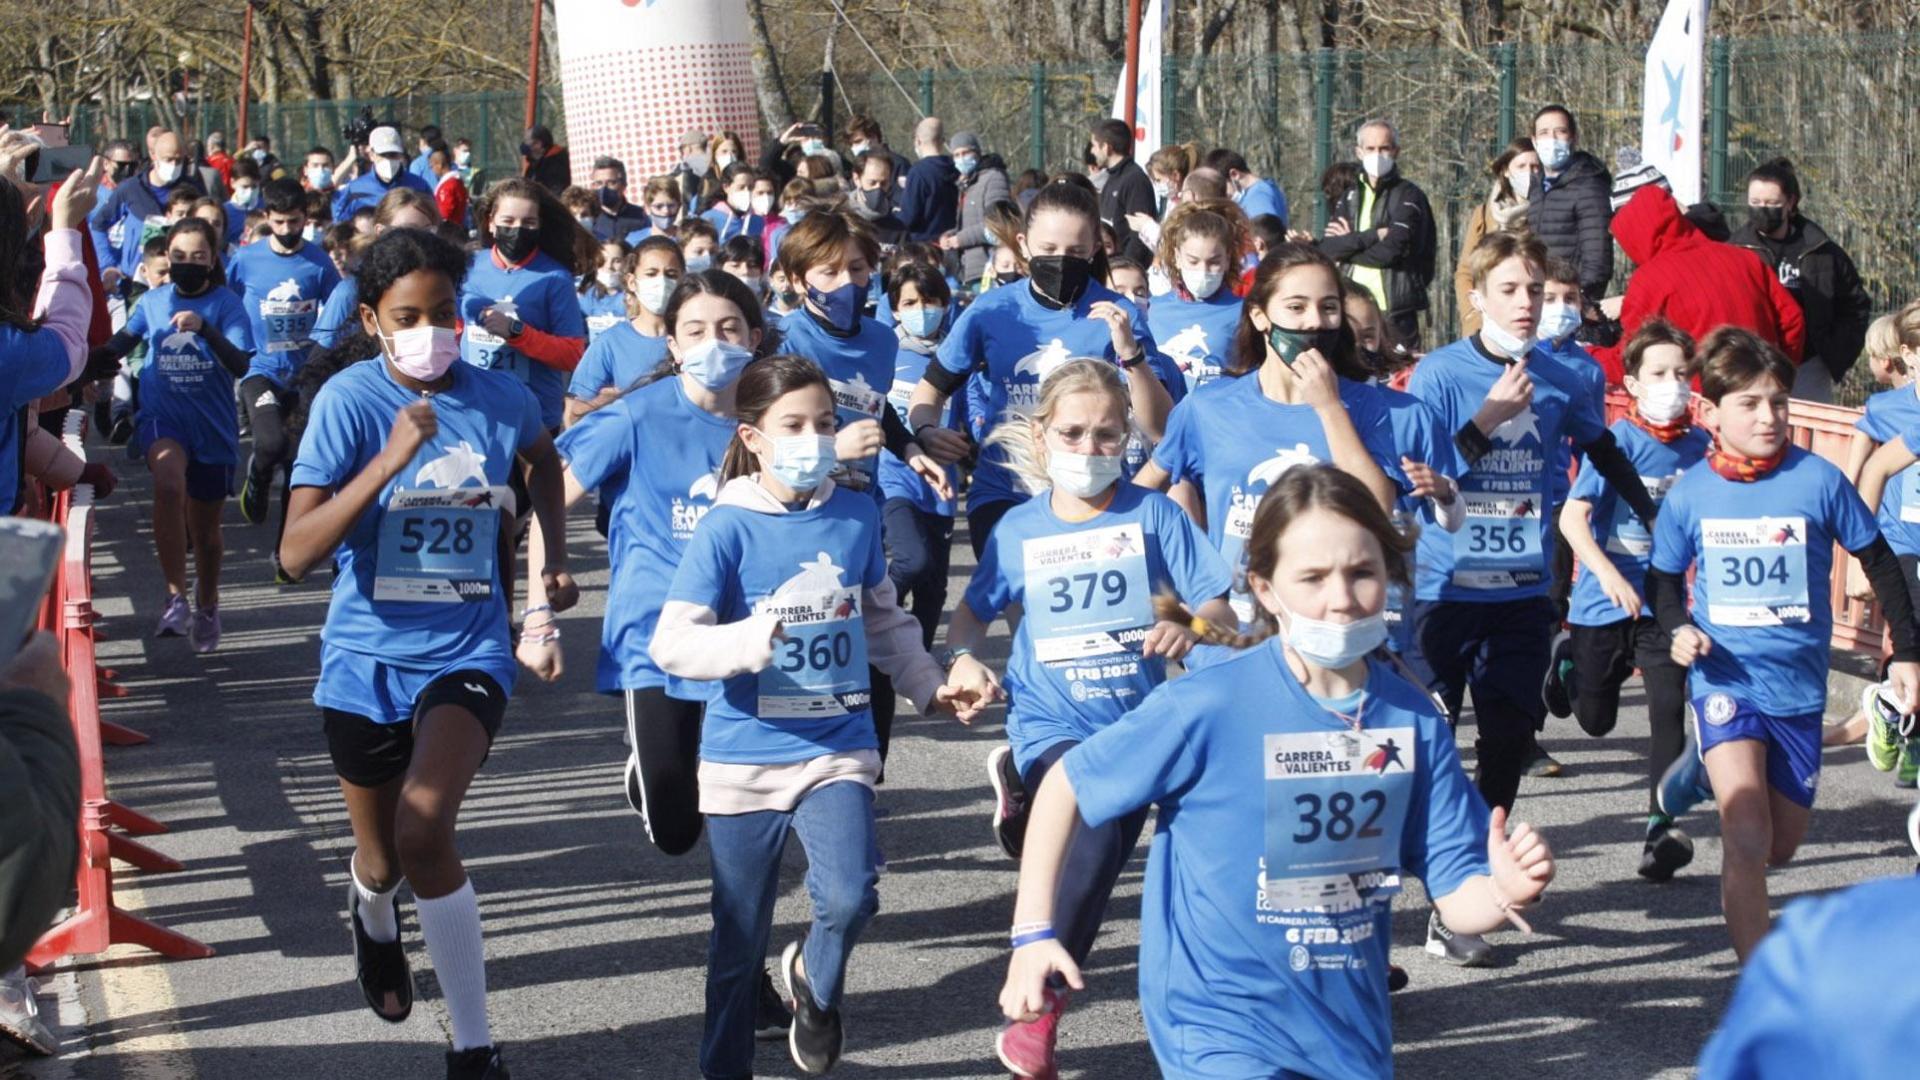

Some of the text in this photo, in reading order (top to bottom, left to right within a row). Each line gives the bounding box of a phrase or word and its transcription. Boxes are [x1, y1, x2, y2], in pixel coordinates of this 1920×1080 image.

[273, 318, 306, 333] 335
[478, 349, 515, 369] 321
[399, 517, 474, 554] 528
[1468, 525, 1527, 553] 356
[1709, 530, 1749, 538] CARRERA
[1040, 551, 1092, 566] VALIENTES
[1721, 554, 1790, 587] 304
[459, 582, 490, 595] 1000m
[1047, 569, 1128, 613] 379
[780, 631, 851, 673] 360
[1065, 662, 1138, 681] 6 FEB 2022
[1275, 751, 1333, 763] CARRERA
[1285, 761, 1351, 774] VALIENTES
[1292, 790, 1386, 844] 382
[1256, 915, 1266, 924] VI
[1267, 915, 1307, 926] CARRERA
[1286, 928, 1300, 943] 6
[1303, 928, 1339, 944] FEB
